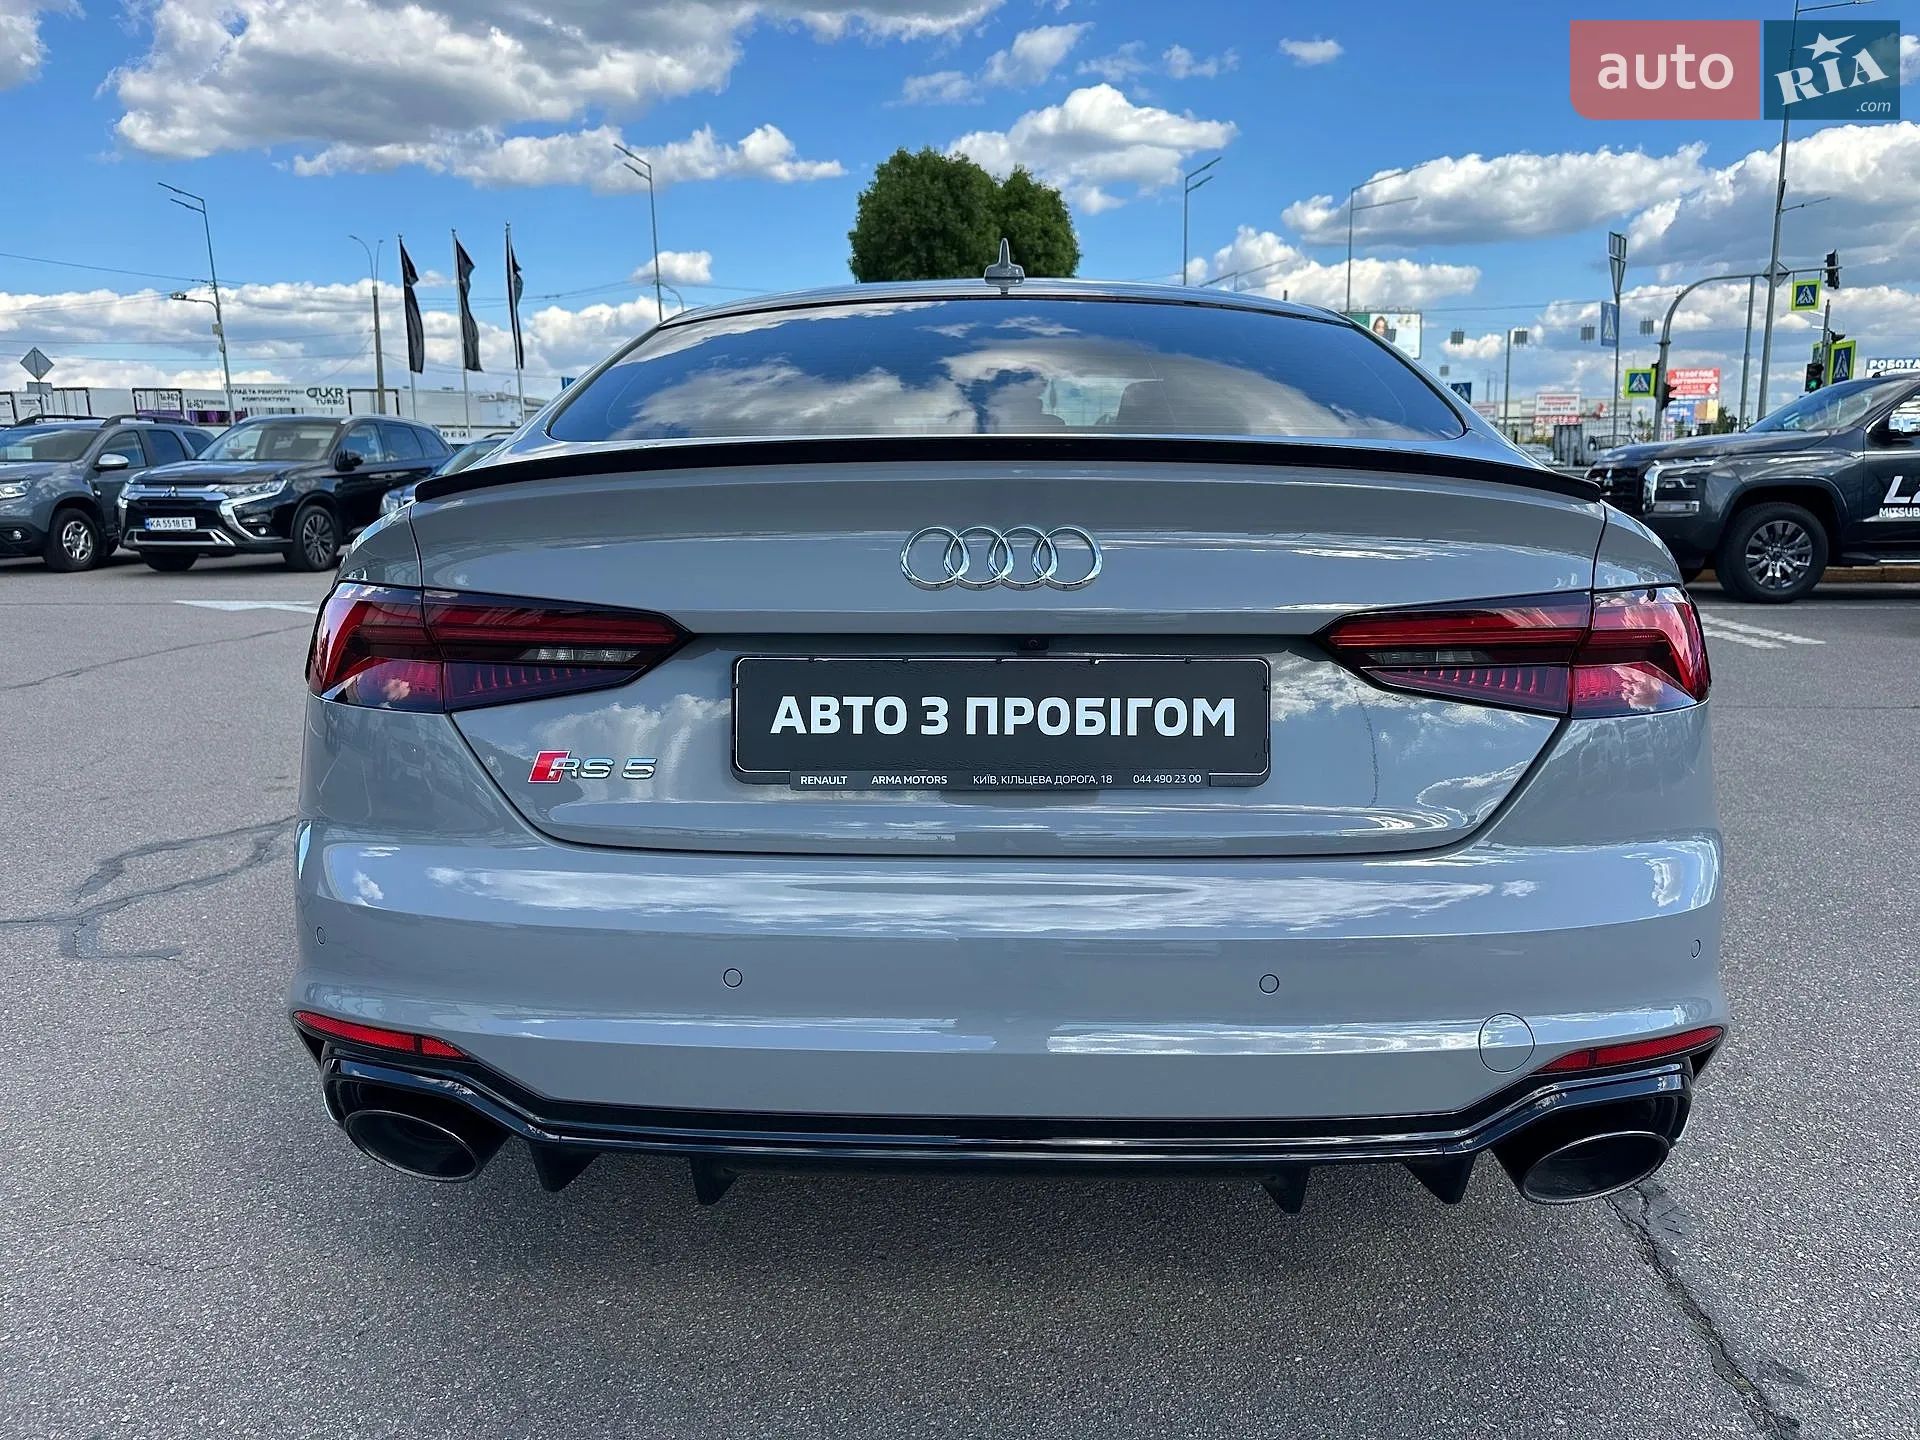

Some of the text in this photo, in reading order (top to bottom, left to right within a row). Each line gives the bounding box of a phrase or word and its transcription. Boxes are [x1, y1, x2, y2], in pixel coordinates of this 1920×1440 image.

[769, 695, 907, 736] АВТО
[966, 696, 1236, 738] ПРОБІГОМ
[547, 757, 657, 780] RS 5
[800, 775, 848, 785] RENAULT
[871, 775, 948, 785] ARMA MOTORS
[973, 774, 1113, 786] КИЇВ, КІЛЬЦЕВА ДОРОГА, 18
[1133, 774, 1202, 783] 044 490 23 00
